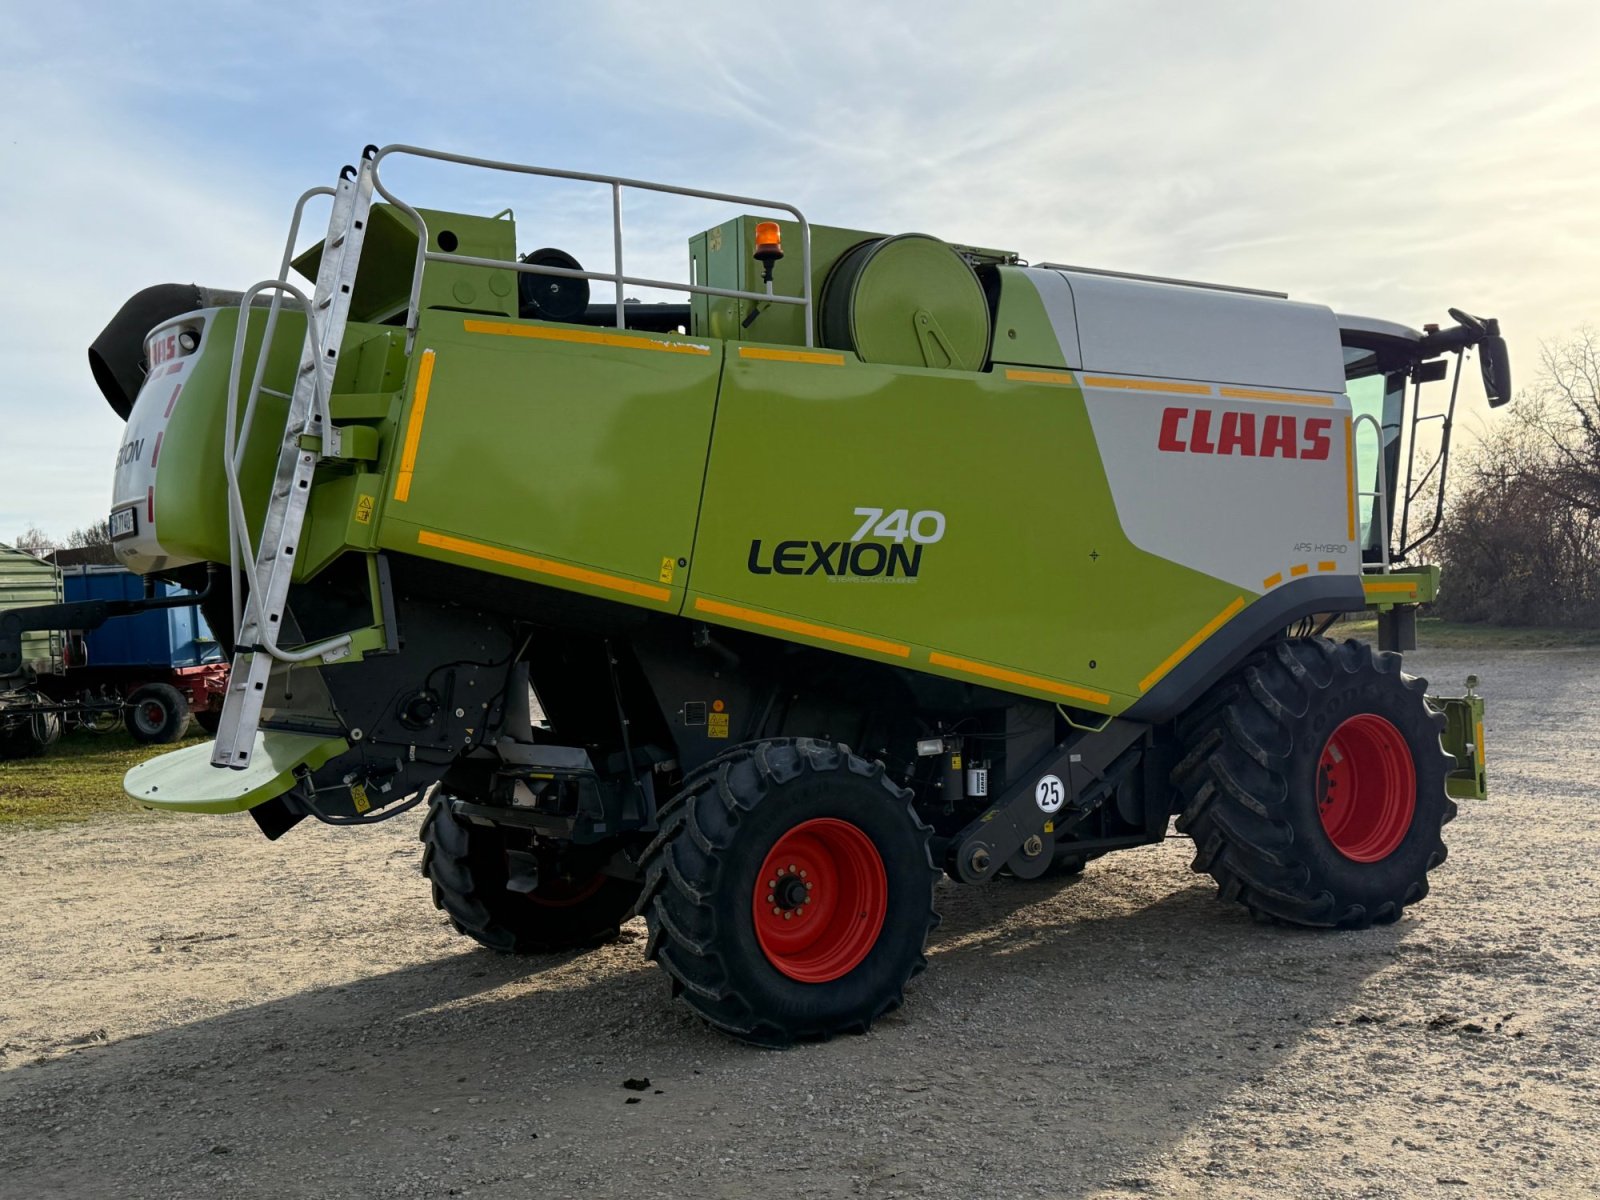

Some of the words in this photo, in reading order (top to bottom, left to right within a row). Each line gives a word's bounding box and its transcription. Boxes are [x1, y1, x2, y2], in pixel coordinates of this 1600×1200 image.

[1158, 407, 1332, 461] CLAAS
[850, 507, 946, 544] 740
[747, 539, 922, 577] LEXION
[1293, 542, 1312, 552] APS
[1314, 543, 1348, 554] HYBRID
[1040, 781, 1060, 806] 25
